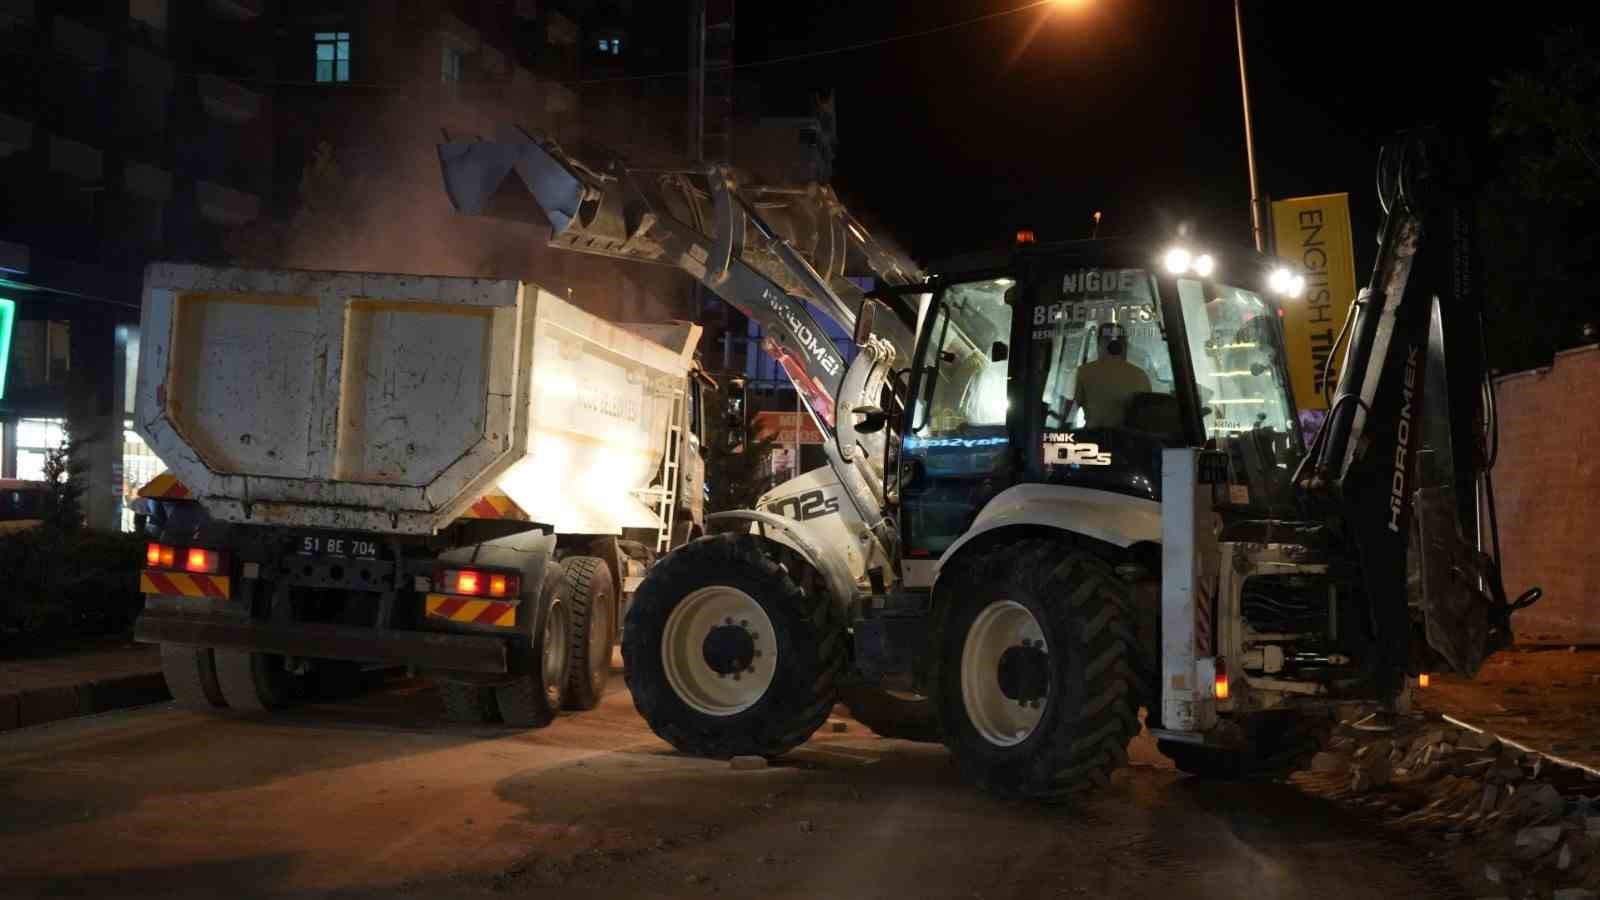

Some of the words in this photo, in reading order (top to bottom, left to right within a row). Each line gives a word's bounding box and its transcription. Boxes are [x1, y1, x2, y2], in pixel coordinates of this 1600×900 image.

[1311, 328, 1338, 395] TIME
[1043, 433, 1075, 442] HMK
[304, 536, 320, 552] 51
[327, 539, 344, 553] BE
[352, 541, 376, 555] 704
